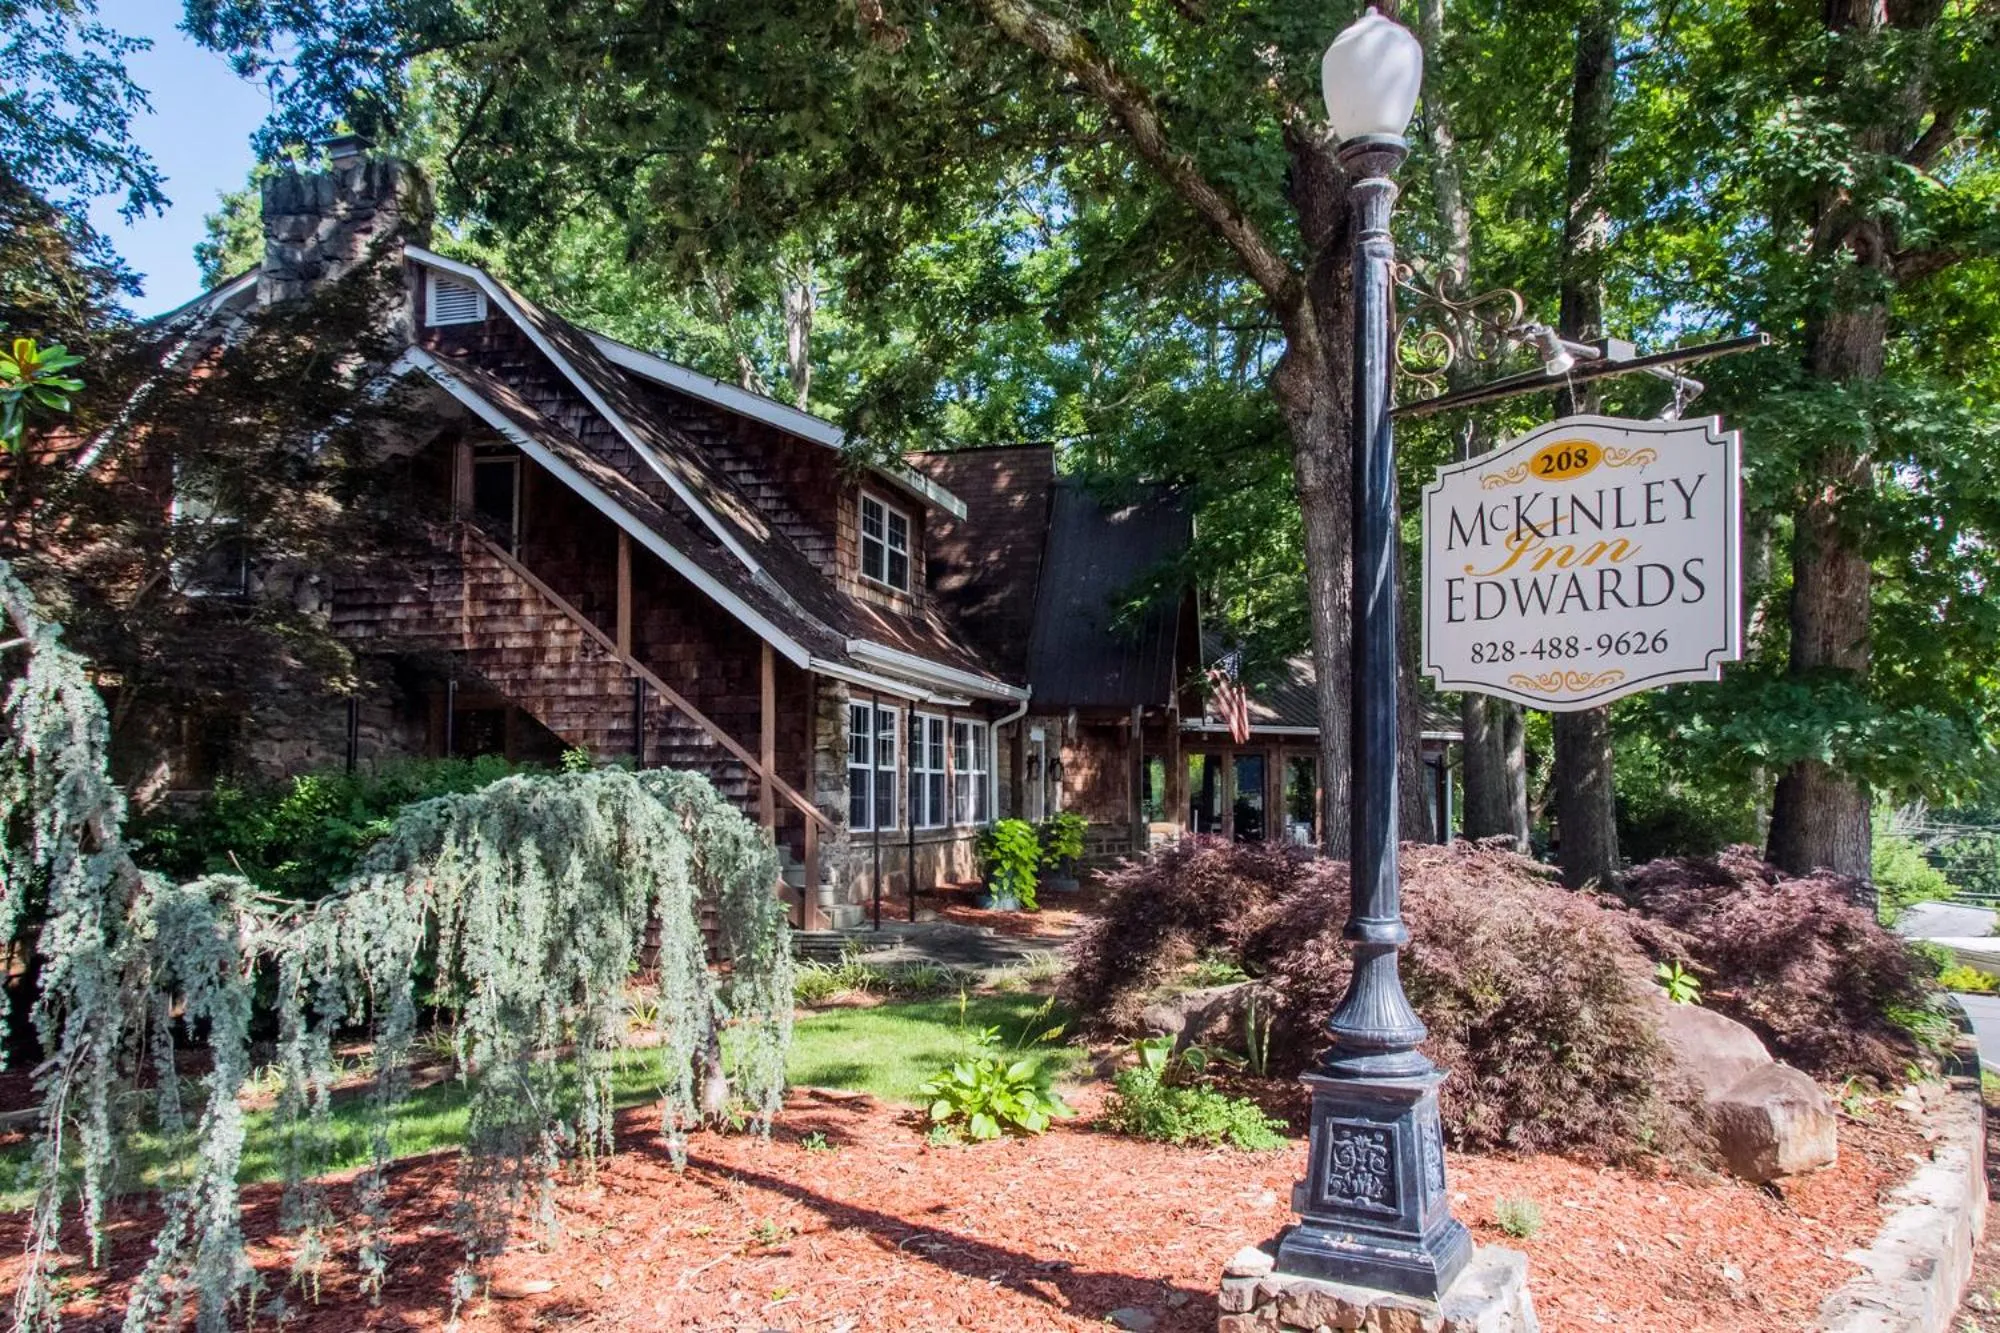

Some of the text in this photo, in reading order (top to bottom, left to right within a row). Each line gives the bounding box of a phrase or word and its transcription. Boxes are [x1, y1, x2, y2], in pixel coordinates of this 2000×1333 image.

[1540, 448, 1589, 474] 208
[1464, 514, 1642, 577] Inn
[1446, 558, 1706, 623] EDWARDS
[1470, 629, 1669, 664] 828-488-9626
